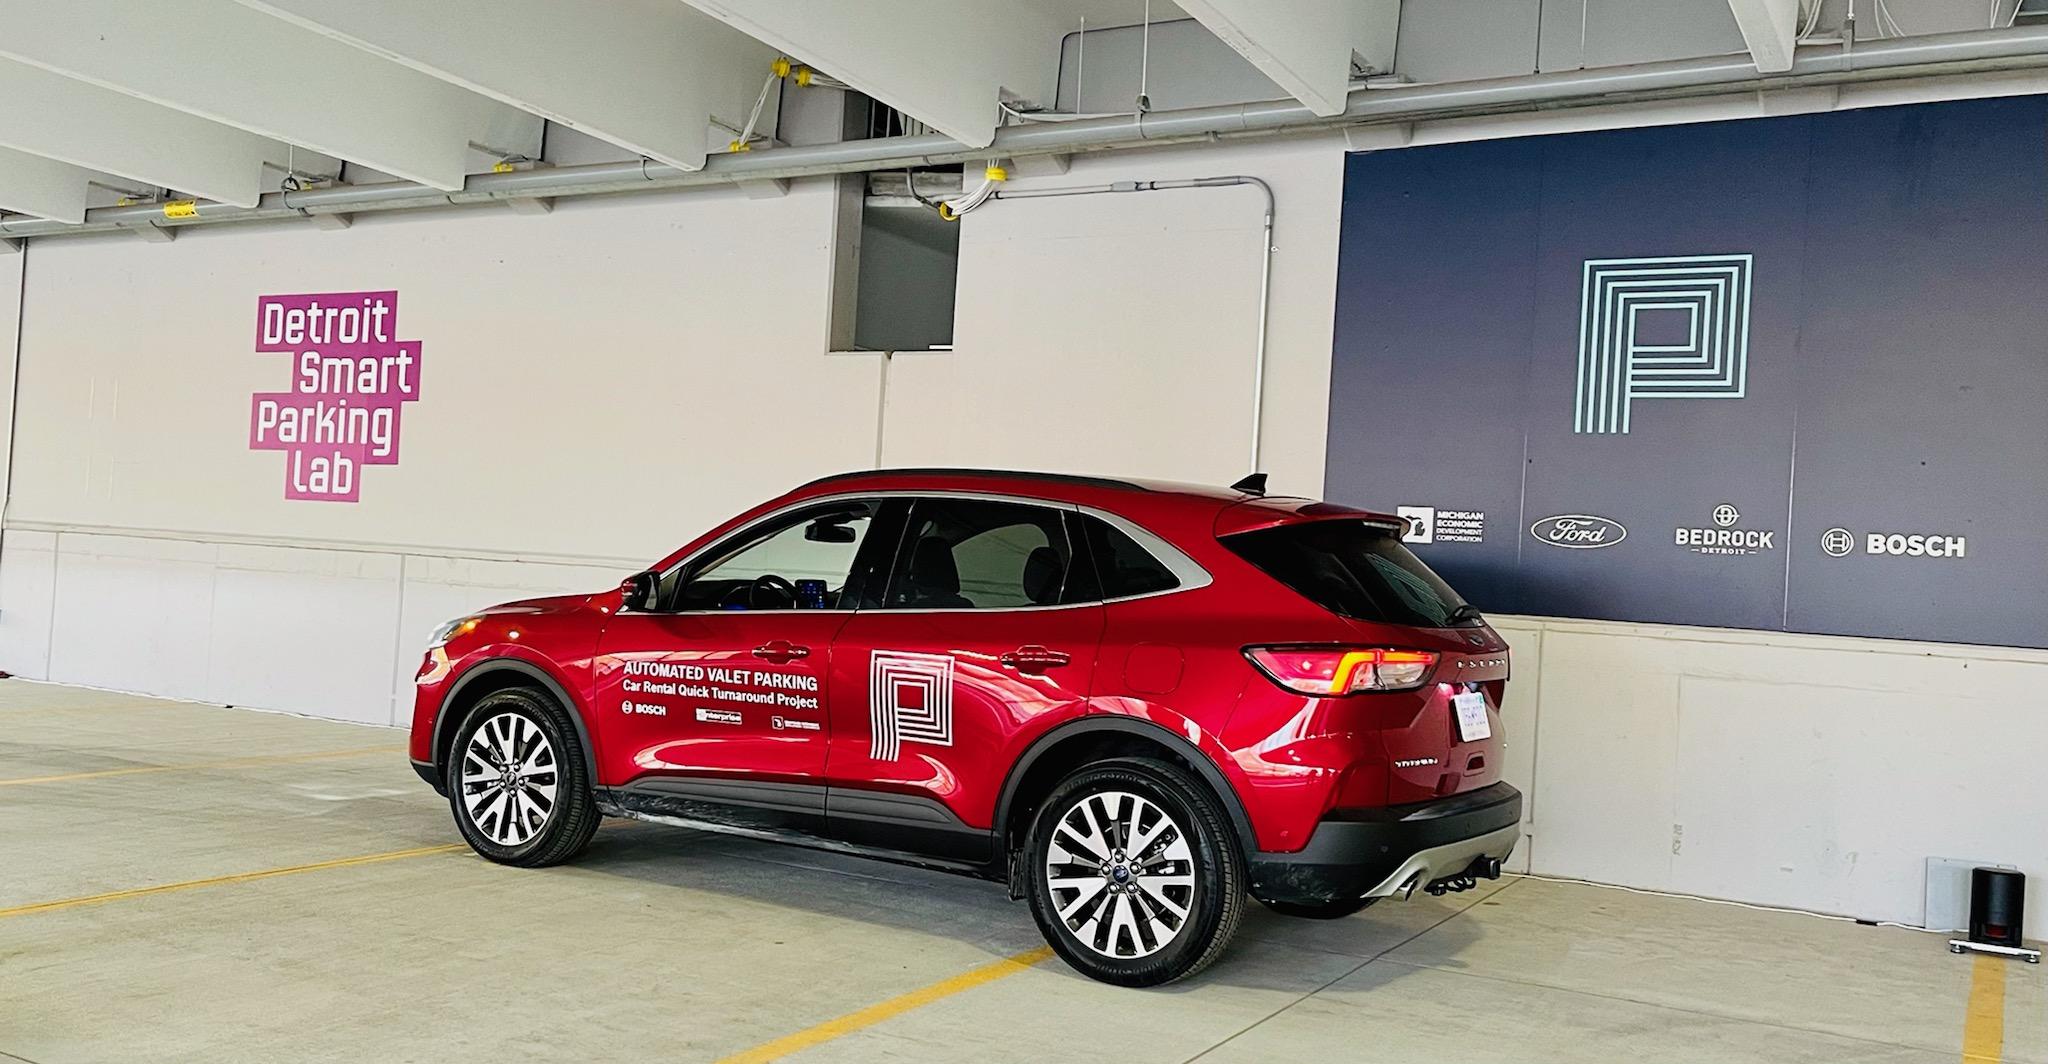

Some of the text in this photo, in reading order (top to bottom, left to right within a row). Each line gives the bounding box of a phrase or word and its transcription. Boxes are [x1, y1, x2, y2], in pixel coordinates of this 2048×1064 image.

[263, 298, 389, 345] Detroit
[300, 349, 413, 394] Smart
[257, 398, 393, 457] Parking
[1437, 511, 1484, 520] MICHIGAN
[1437, 519, 1483, 529] ECONOMIC
[1436, 527, 1483, 536] DEVELOPMENT
[1436, 534, 1483, 543] CORPORATION
[1549, 518, 1607, 542] Ford
[1675, 528, 1774, 549] BEDROCK
[1701, 547, 1746, 556] DETROIT
[1866, 533, 1966, 558] BOSCH
[623, 660, 818, 691] AUTOMATED VALET PARKING
[622, 679, 818, 709] Car Rental Quick Turnaround Project
[635, 703, 667, 716] BOSCH
